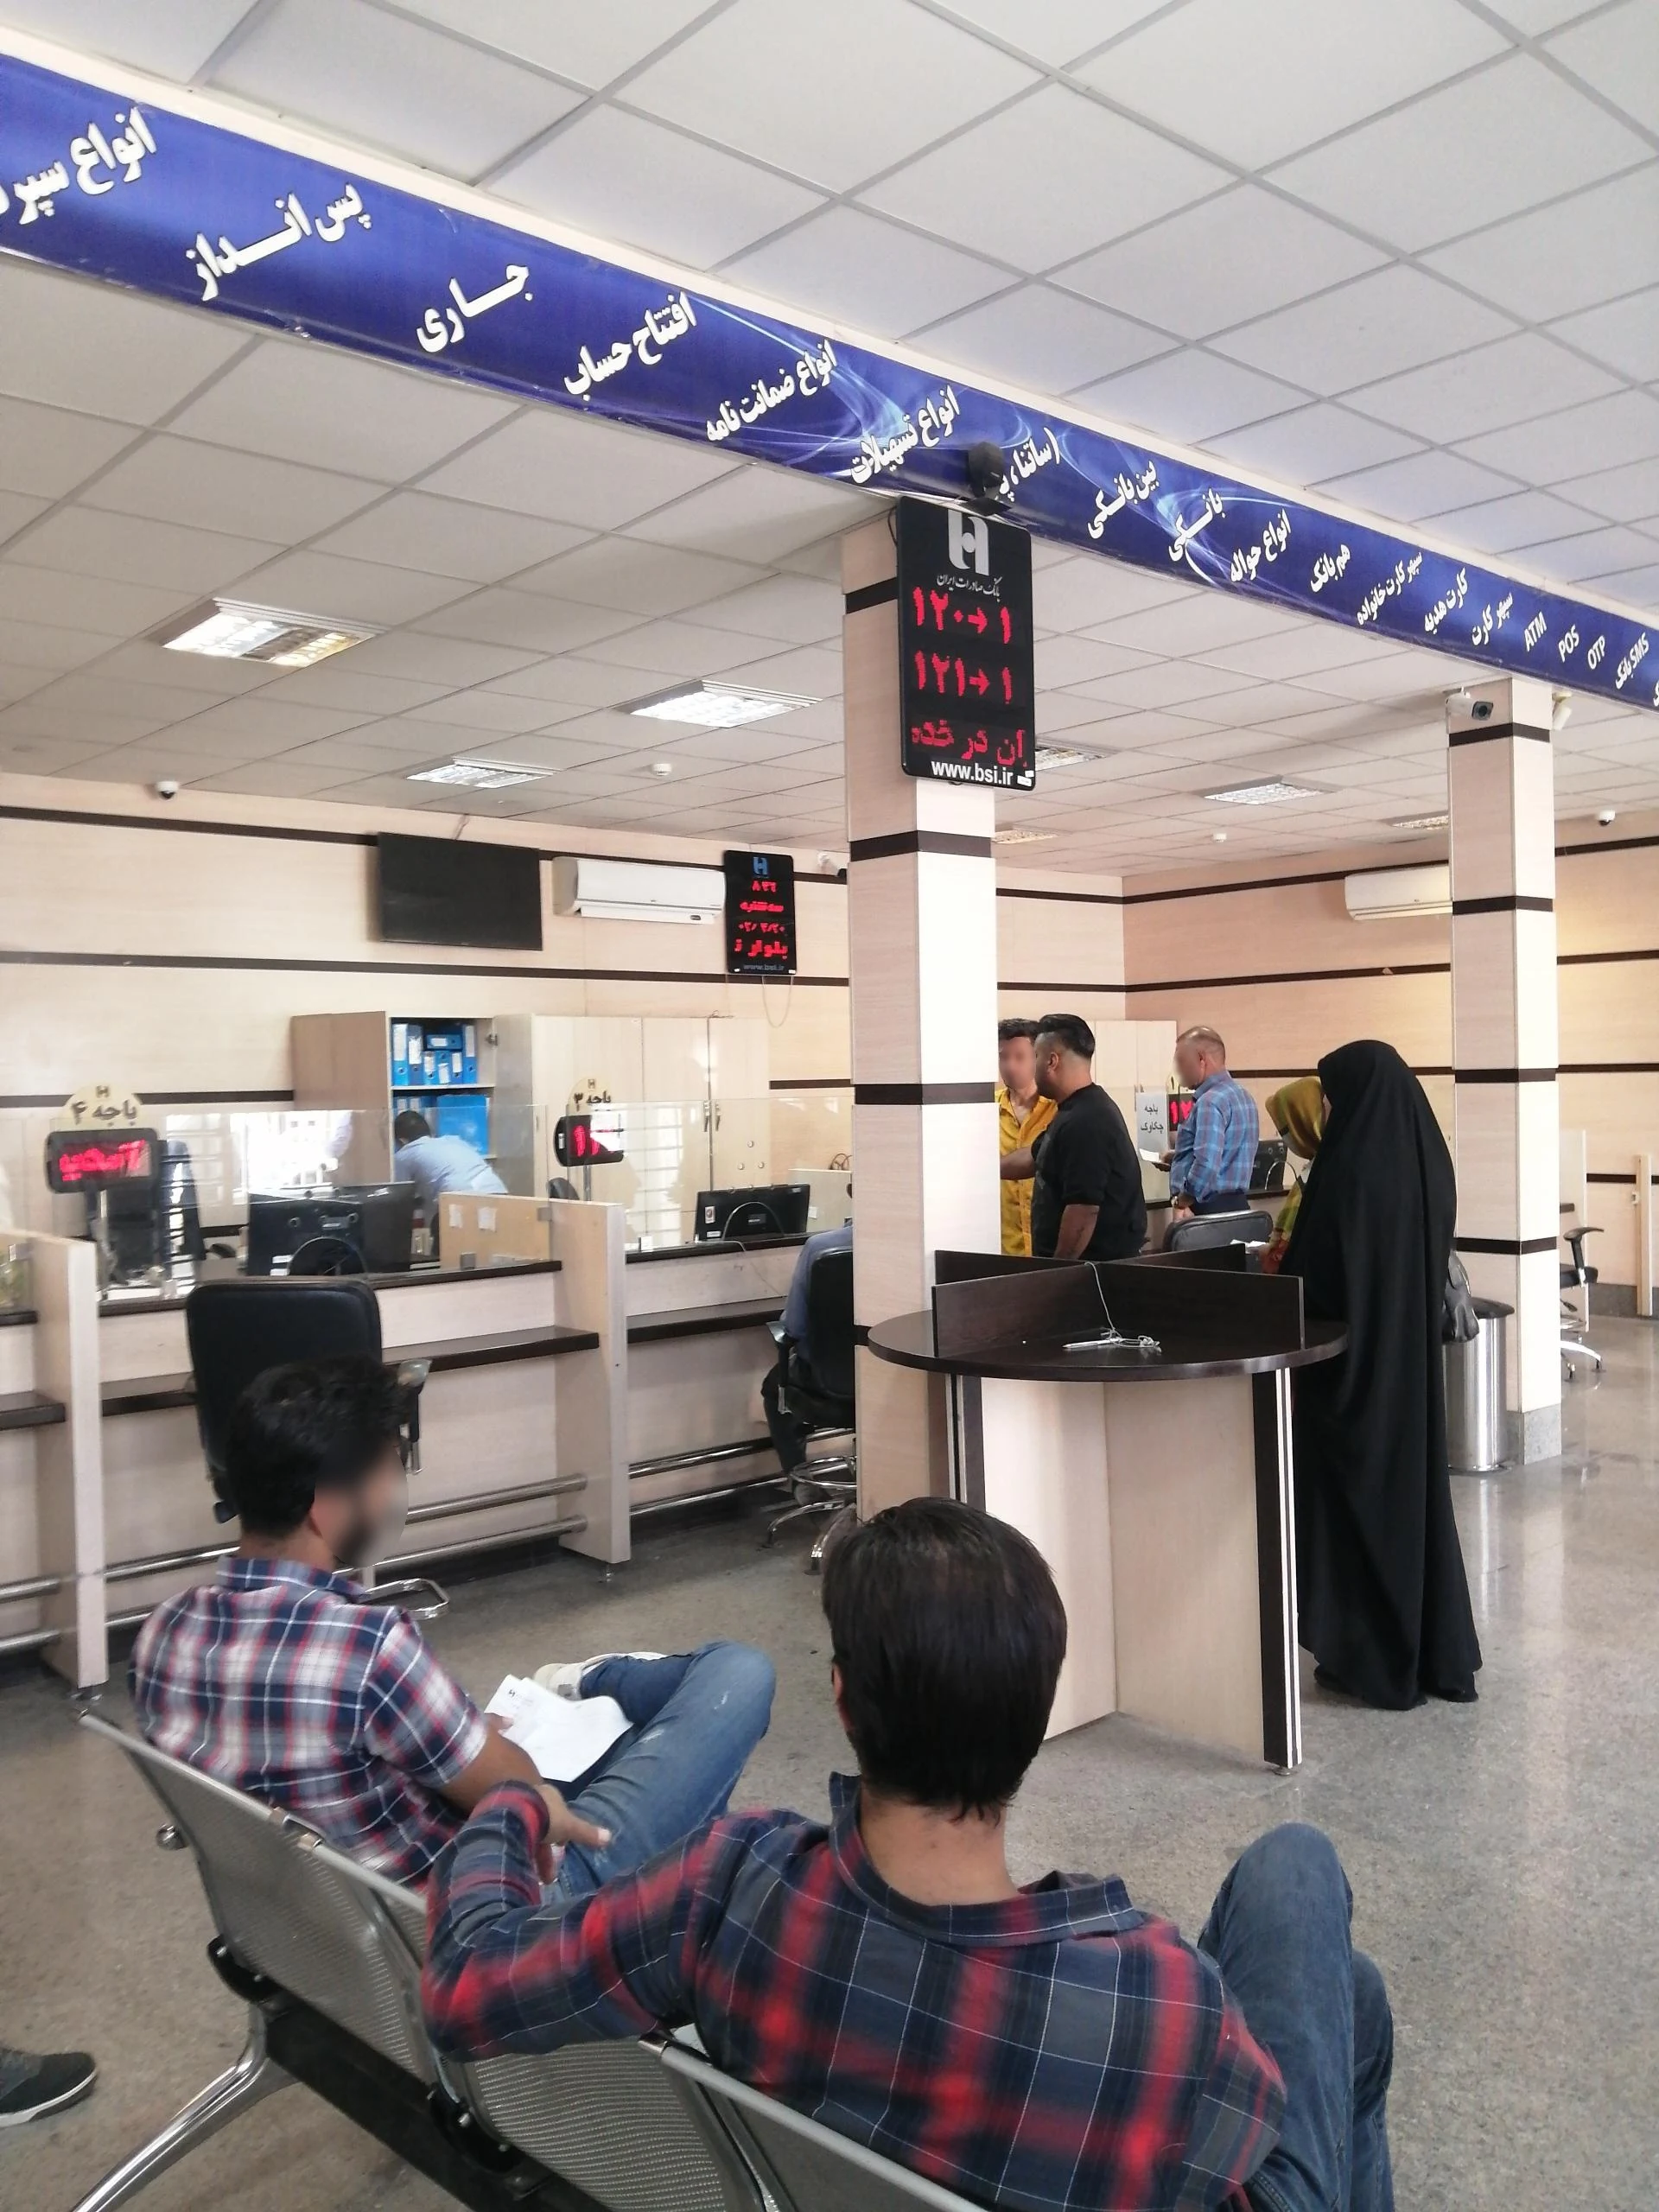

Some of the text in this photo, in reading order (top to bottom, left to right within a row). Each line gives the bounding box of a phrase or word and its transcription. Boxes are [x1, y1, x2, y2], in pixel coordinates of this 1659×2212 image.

[0, 106, 157, 225] انواع سپر
[185, 183, 372, 301] پس انداز
[416, 262, 533, 353] جاری
[563, 290, 697, 401] افتتاح حساب
[706, 339, 838, 441] انواع ضمانت نامه
[850, 385, 960, 484] انواع تسهیلات
[1087, 461, 1160, 539] بین بانکی
[1168, 488, 1226, 562] بانکی
[1230, 508, 1292, 582] انواع حواله
[937, 574, 956, 591] ایران
[982, 576, 1003, 602] بانک
[1385, 560, 1404, 596] کارت
[1357, 582, 1386, 626] خانواده
[1424, 566, 1468, 634] کارت هدیه
[1471, 604, 1494, 645] کارت
[1523, 611, 1548, 652] ATM
[1558, 624, 1580, 663] POS
[1587, 634, 1606, 670] OTP
[1629, 632, 1649, 670] SMS
[931, 760, 1014, 785] www.bsi.ir
[71, 1099, 137, 1126] باجه ۴
[1144, 1103, 1159, 1116] باجه
